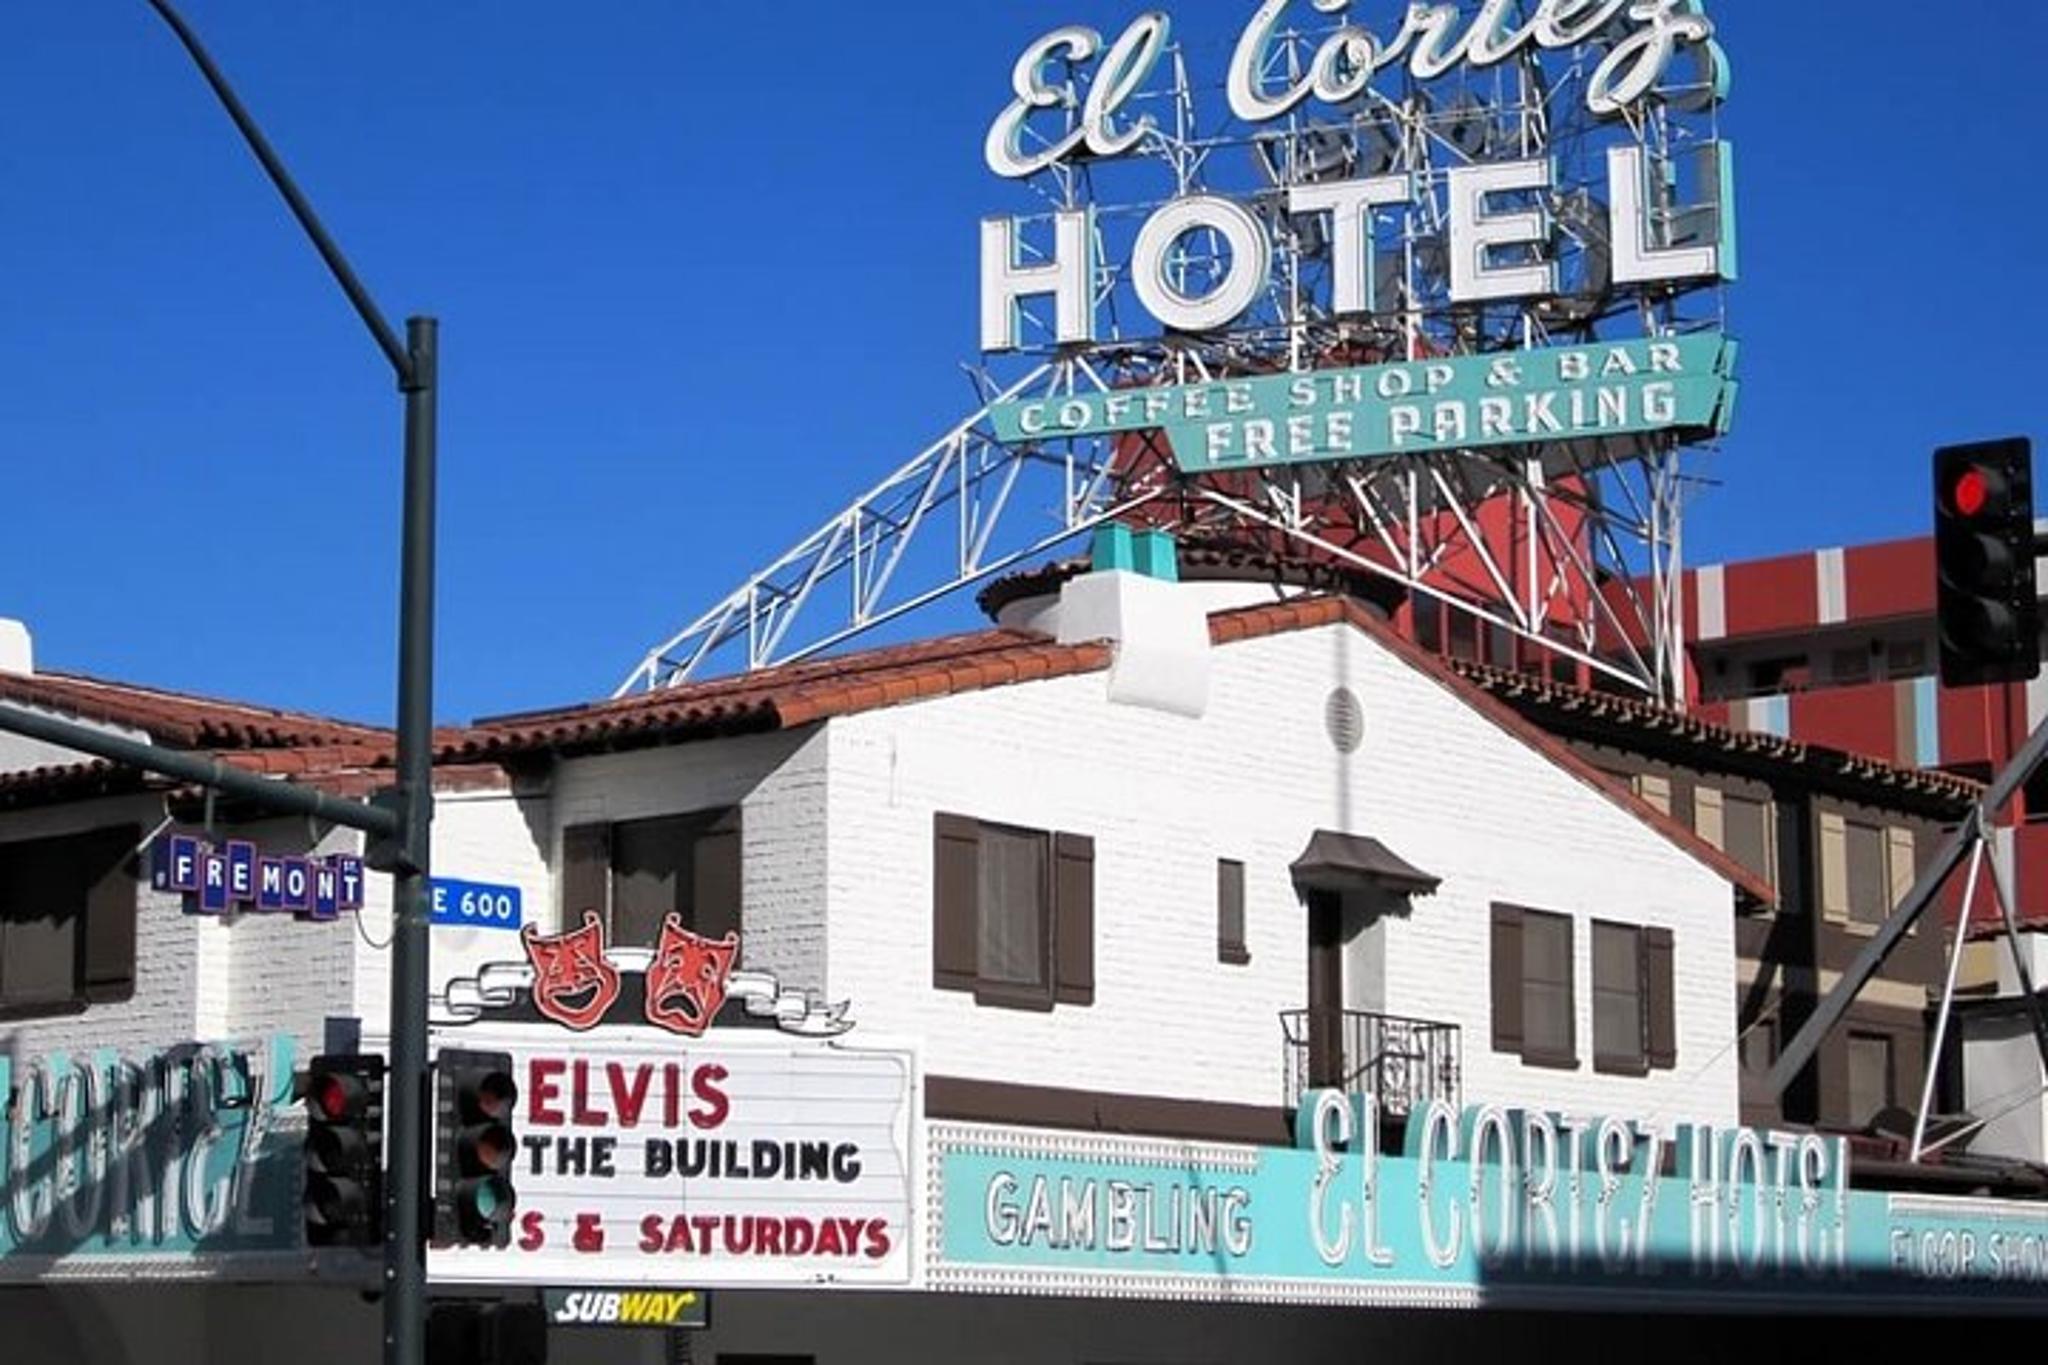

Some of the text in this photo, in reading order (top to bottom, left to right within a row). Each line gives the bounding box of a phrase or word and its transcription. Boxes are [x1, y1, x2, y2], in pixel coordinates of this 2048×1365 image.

[984, 12, 1171, 178] El
[981, 146, 1720, 351] HOTEL
[1019, 342, 1683, 434] COFFEE SHOP & BAR
[1205, 381, 1677, 463] FREE PARKING
[177, 855, 360, 902] FREMONT
[461, 891, 511, 919] 600
[527, 1057, 731, 1129] ELVIS
[522, 1136, 861, 1183] THE BUILDING
[1307, 1087, 1395, 1268] EL
[1418, 1101, 1678, 1270] CORTEZ
[572, 1213, 604, 1253] &
[639, 1213, 892, 1260] SATURDAYS
[984, 1171, 1252, 1257] GAMBLING
[554, 1290, 697, 1323] SUBWAY
